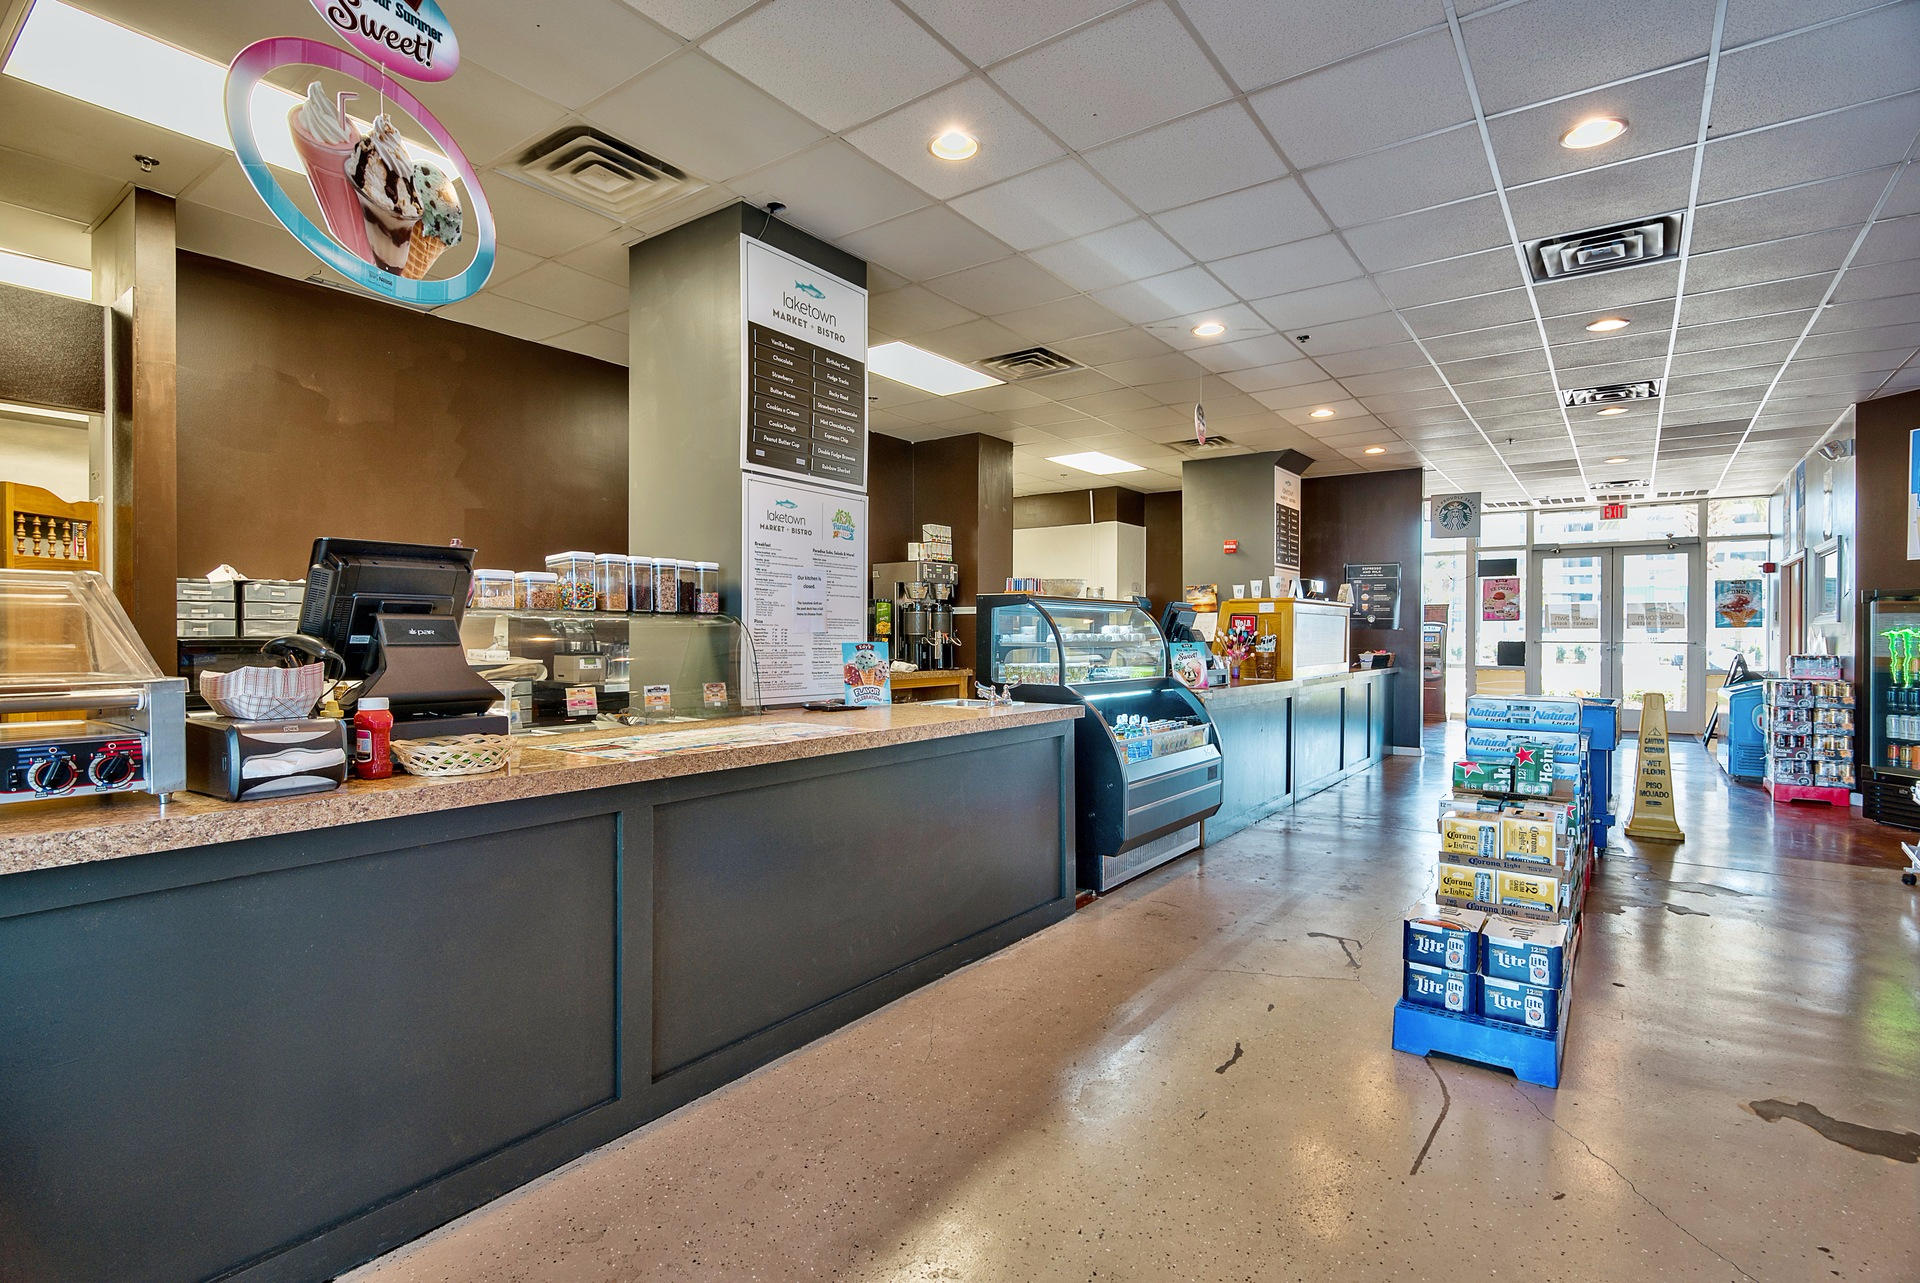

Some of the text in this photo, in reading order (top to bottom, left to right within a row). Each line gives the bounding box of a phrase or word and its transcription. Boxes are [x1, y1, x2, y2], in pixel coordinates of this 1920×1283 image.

[396, 2, 442, 43] Summer
[328, 0, 433, 67] Sweet!
[782, 292, 837, 327] laketown
[772, 308, 845, 343] MARKET BISTRO
[771, 339, 784, 348] Vanilla
[772, 355, 793, 366] Chocolate
[826, 358, 840, 368] Birthday
[772, 371, 794, 383] Strawberry
[827, 374, 838, 382] Fudge
[770, 387, 783, 396] Butter
[829, 390, 839, 399] Rocky
[766, 403, 782, 412] Cookies
[786, 408, 799, 416] Cream
[818, 403, 858, 418] Strawberry Cheesecake
[769, 420, 796, 432] Cookie Dough
[829, 421, 846, 430] Chocolate
[764, 435, 778, 443] Peanut
[818, 448, 830, 456] Double
[830, 451, 841, 459] Fudge
[767, 510, 806, 525] laketown
[1604, 505, 1624, 519] EXIT
[760, 524, 812, 536] MARKET BISTRO
[853, 687, 880, 697] FLAVOR
[1469, 708, 1508, 718] Natural
[1534, 710, 1576, 721] Natural
[1469, 737, 1577, 752] Natural ural
[1642, 768, 1666, 776] FLOOR
[1640, 790, 1669, 798] MOJADO
[1447, 831, 1476, 841] Corona
[1468, 858, 1501, 867] Corona
[1443, 877, 1472, 887] Corona
[1525, 882, 1538, 894] 12
[1466, 902, 1519, 916] Corona Light
[1417, 937, 1464, 954] Lite Lite
[1498, 952, 1526, 968] Lite
[1531, 957, 1547, 966] Lite
[1416, 977, 1443, 994] Lite
[1448, 982, 1463, 992] Lite
[1492, 993, 1521, 1010] Lite
[1526, 998, 1542, 1009] Lite
